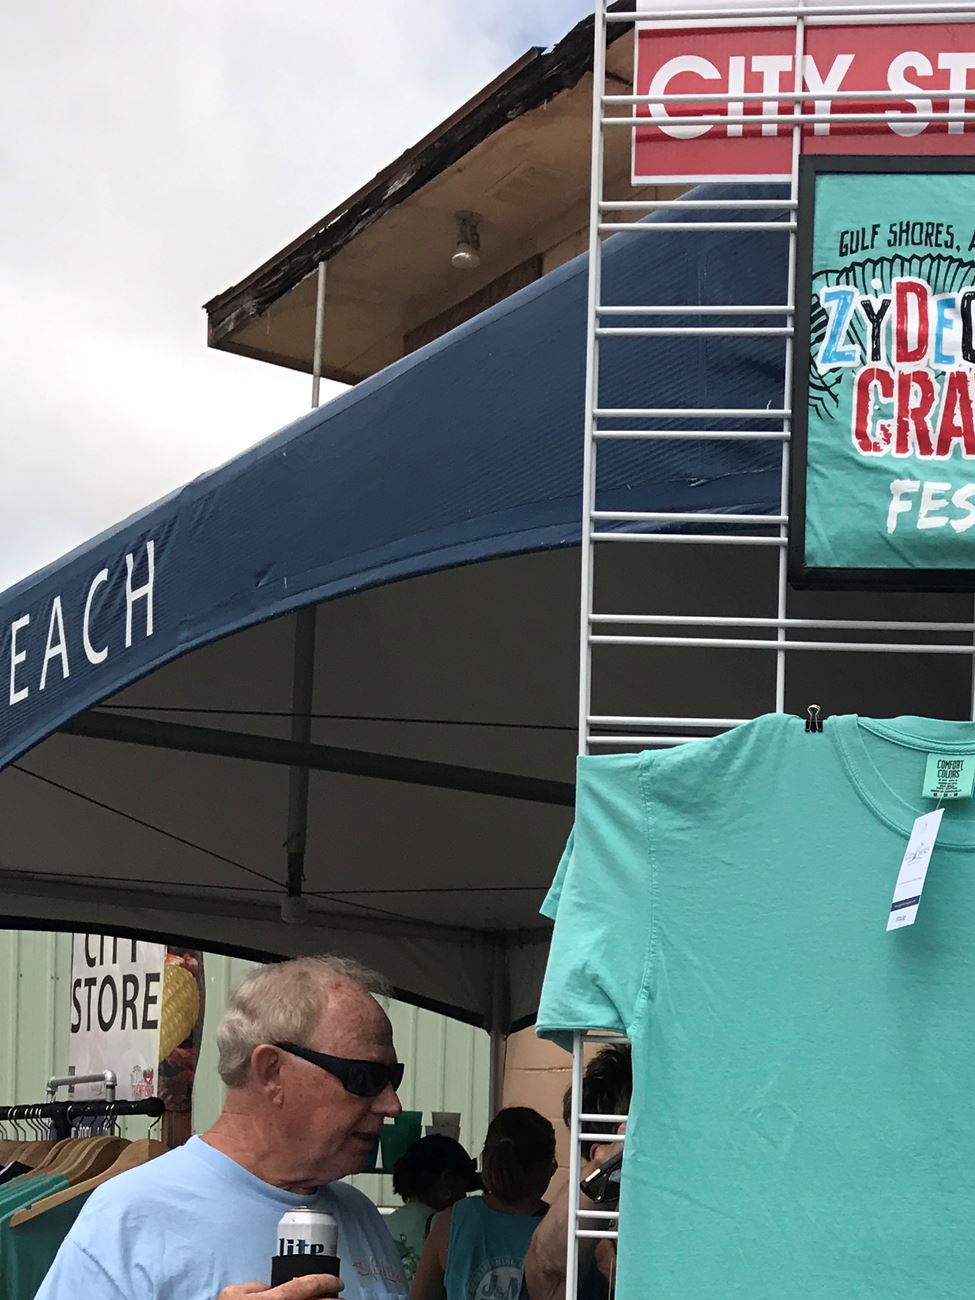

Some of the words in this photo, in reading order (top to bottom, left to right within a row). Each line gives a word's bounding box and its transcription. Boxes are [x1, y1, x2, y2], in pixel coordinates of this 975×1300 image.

[648, 54, 855, 139] CITY
[838, 223, 881, 257] GULF
[887, 221, 961, 253] SHORES,
[9, 539, 156, 706] EACH
[937, 759, 964, 771] COMFORT
[937, 769, 960, 779] COLORS
[70, 972, 161, 1034] STORE
